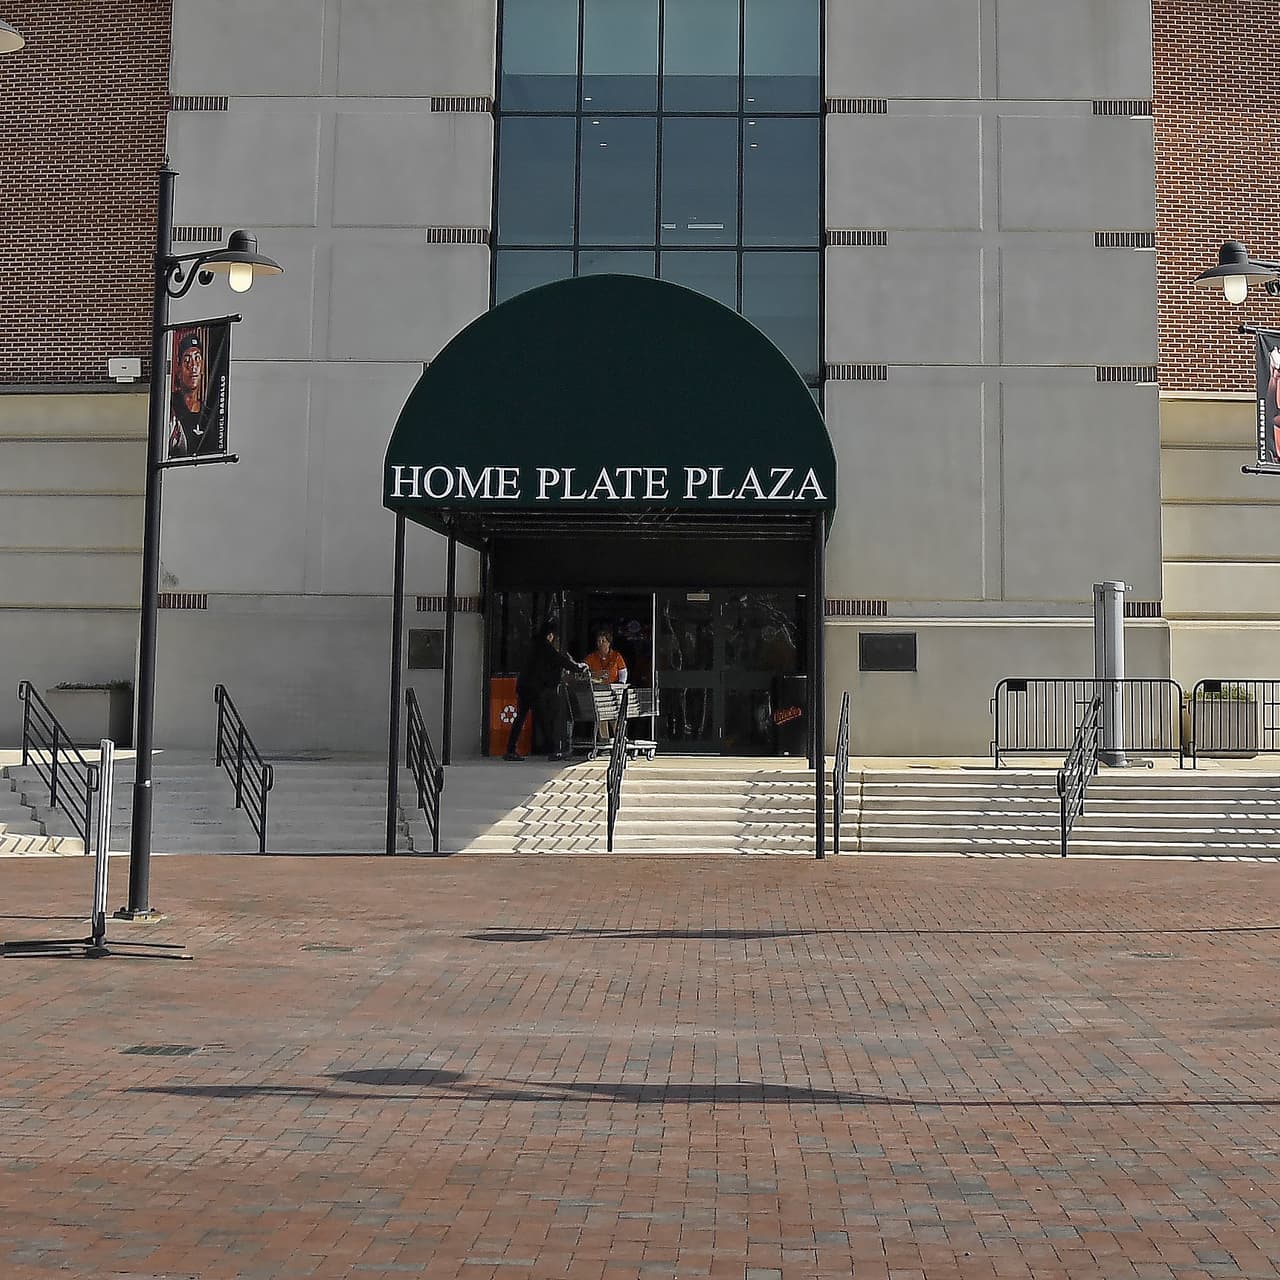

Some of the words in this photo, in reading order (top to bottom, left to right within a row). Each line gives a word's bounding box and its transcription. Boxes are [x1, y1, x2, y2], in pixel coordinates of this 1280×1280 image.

[389, 465, 521, 499] HOME
[535, 465, 671, 500] PLATE
[683, 466, 828, 501] PLAZA
